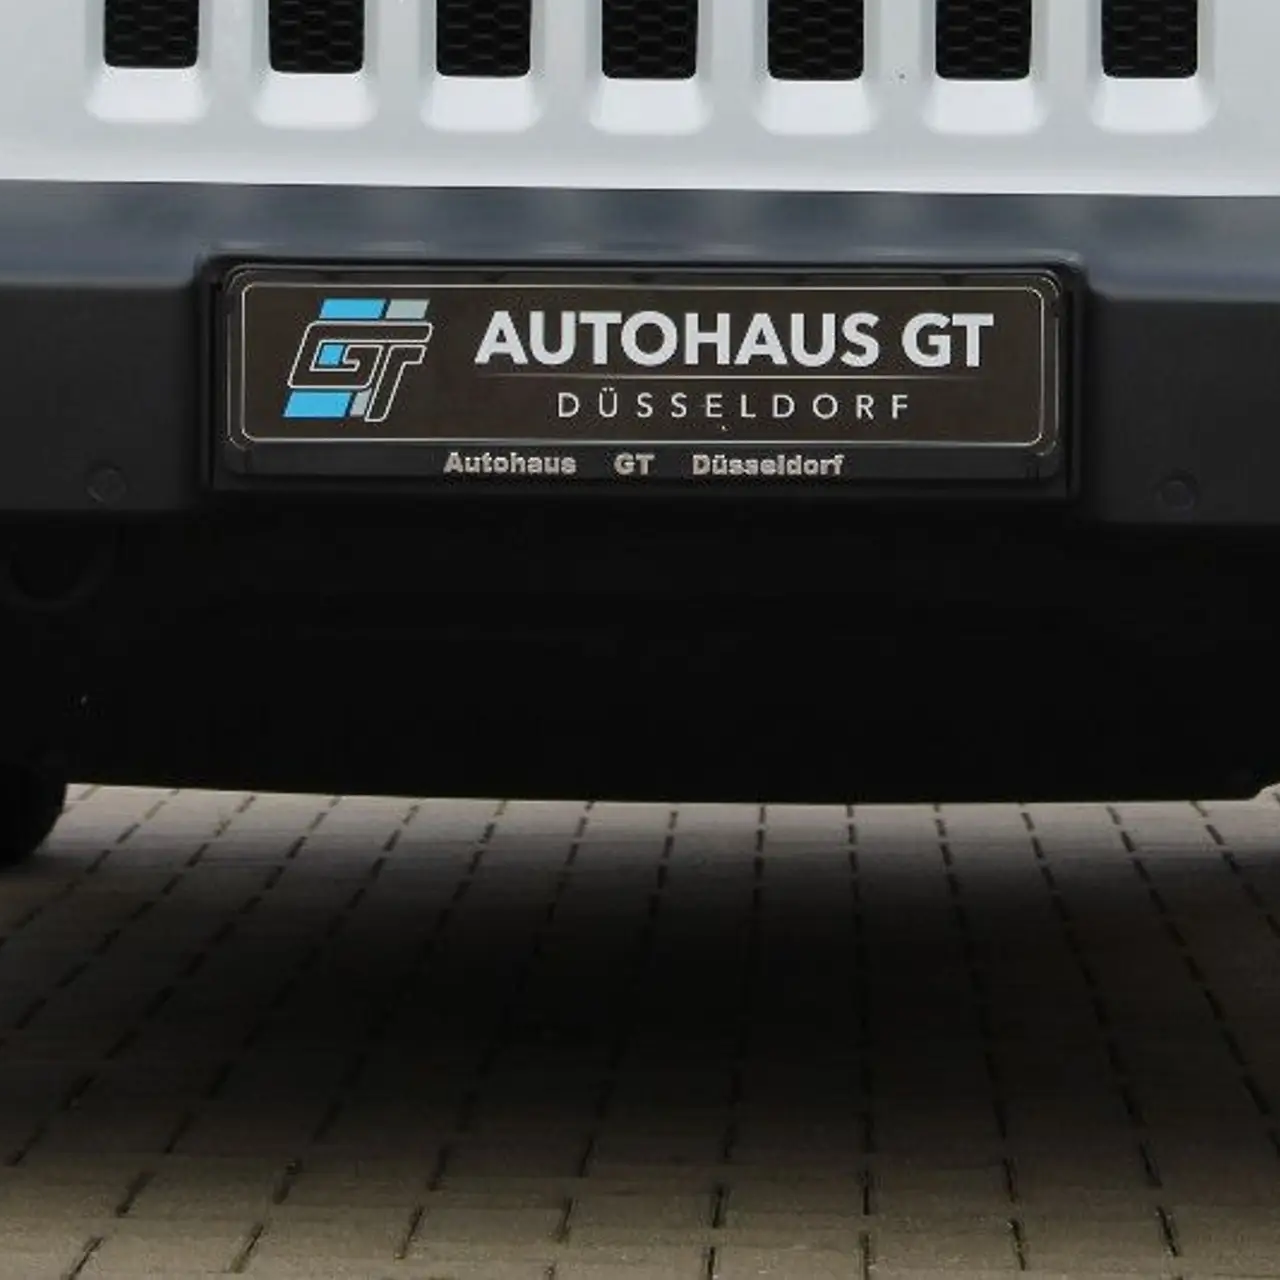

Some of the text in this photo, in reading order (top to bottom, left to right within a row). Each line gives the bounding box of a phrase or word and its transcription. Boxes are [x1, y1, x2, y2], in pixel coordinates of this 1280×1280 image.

[474, 310, 995, 368] AUTOHAUS GT
[557, 386, 910, 421] DÜSSELDORF
[443, 451, 845, 477] Autohaus GT Düsseldorf
